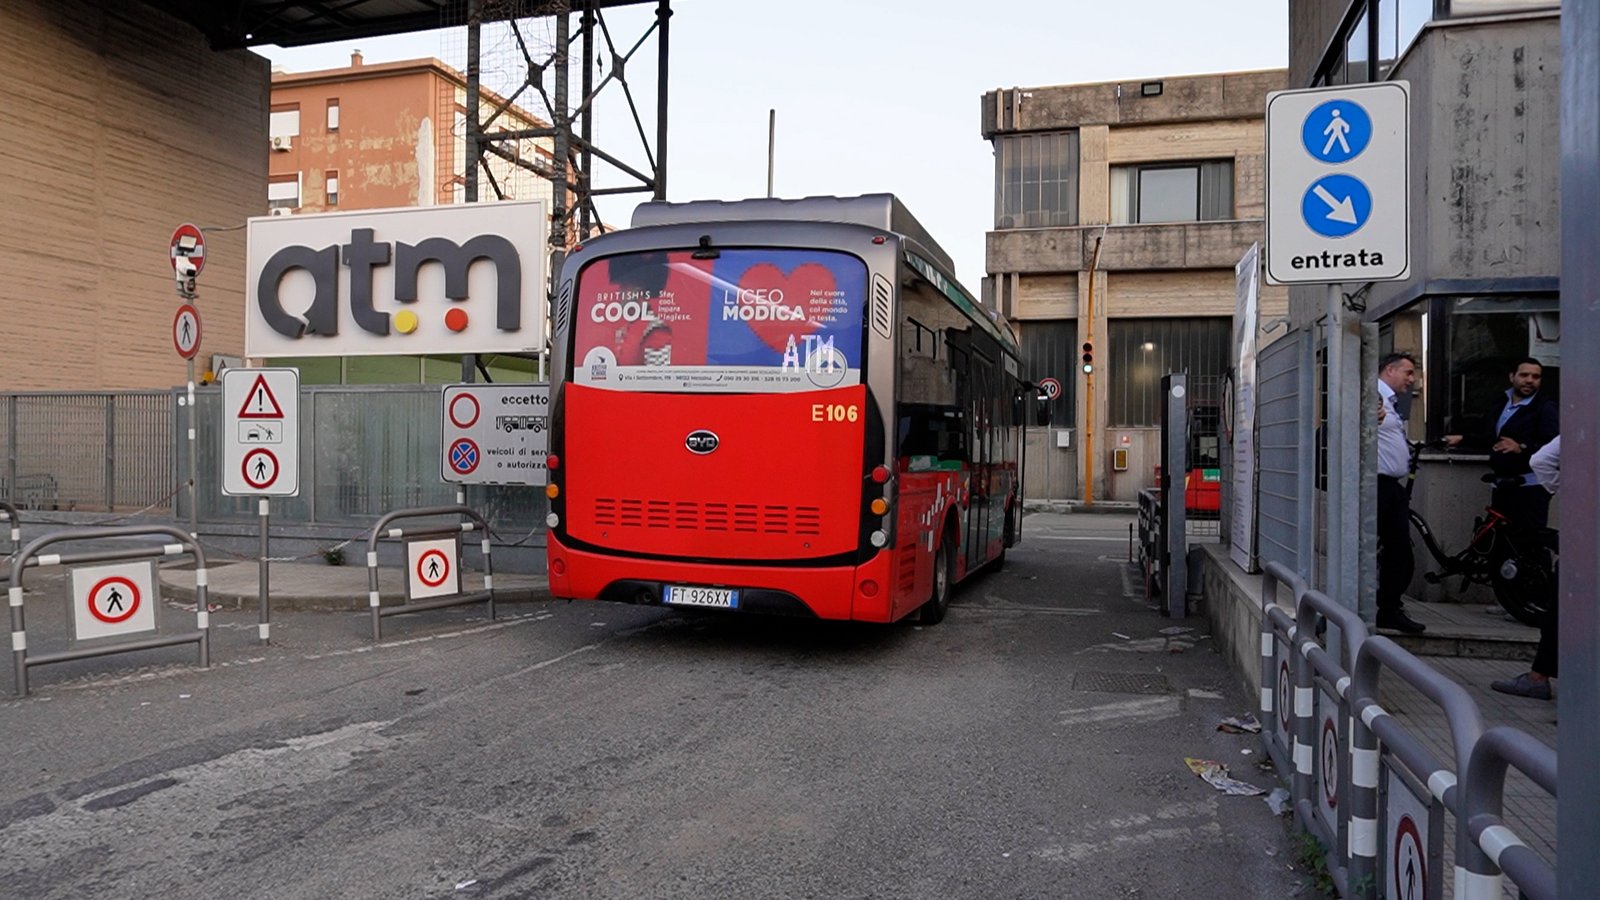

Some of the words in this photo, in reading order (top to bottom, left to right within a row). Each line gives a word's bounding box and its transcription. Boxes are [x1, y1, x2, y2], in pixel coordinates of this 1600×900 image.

[1291, 248, 1384, 269] entrata
[257, 227, 522, 339] atm
[597, 290, 651, 301] BRITISH'S
[659, 290, 675, 298] Stay
[724, 289, 784, 305] LICEO
[809, 289, 823, 297] Nel
[591, 301, 656, 323] COOL
[722, 305, 806, 321] MODICA
[782, 333, 835, 374] ATM
[501, 394, 549, 405] eccetto
[811, 404, 858, 422] E106
[688, 437, 715, 448] BYD
[487, 447, 515, 456] veicoli
[518, 447, 527, 456] di
[507, 461, 547, 469] autorizza
[671, 588, 686, 602] FT
[691, 590, 729, 605] 926XX
